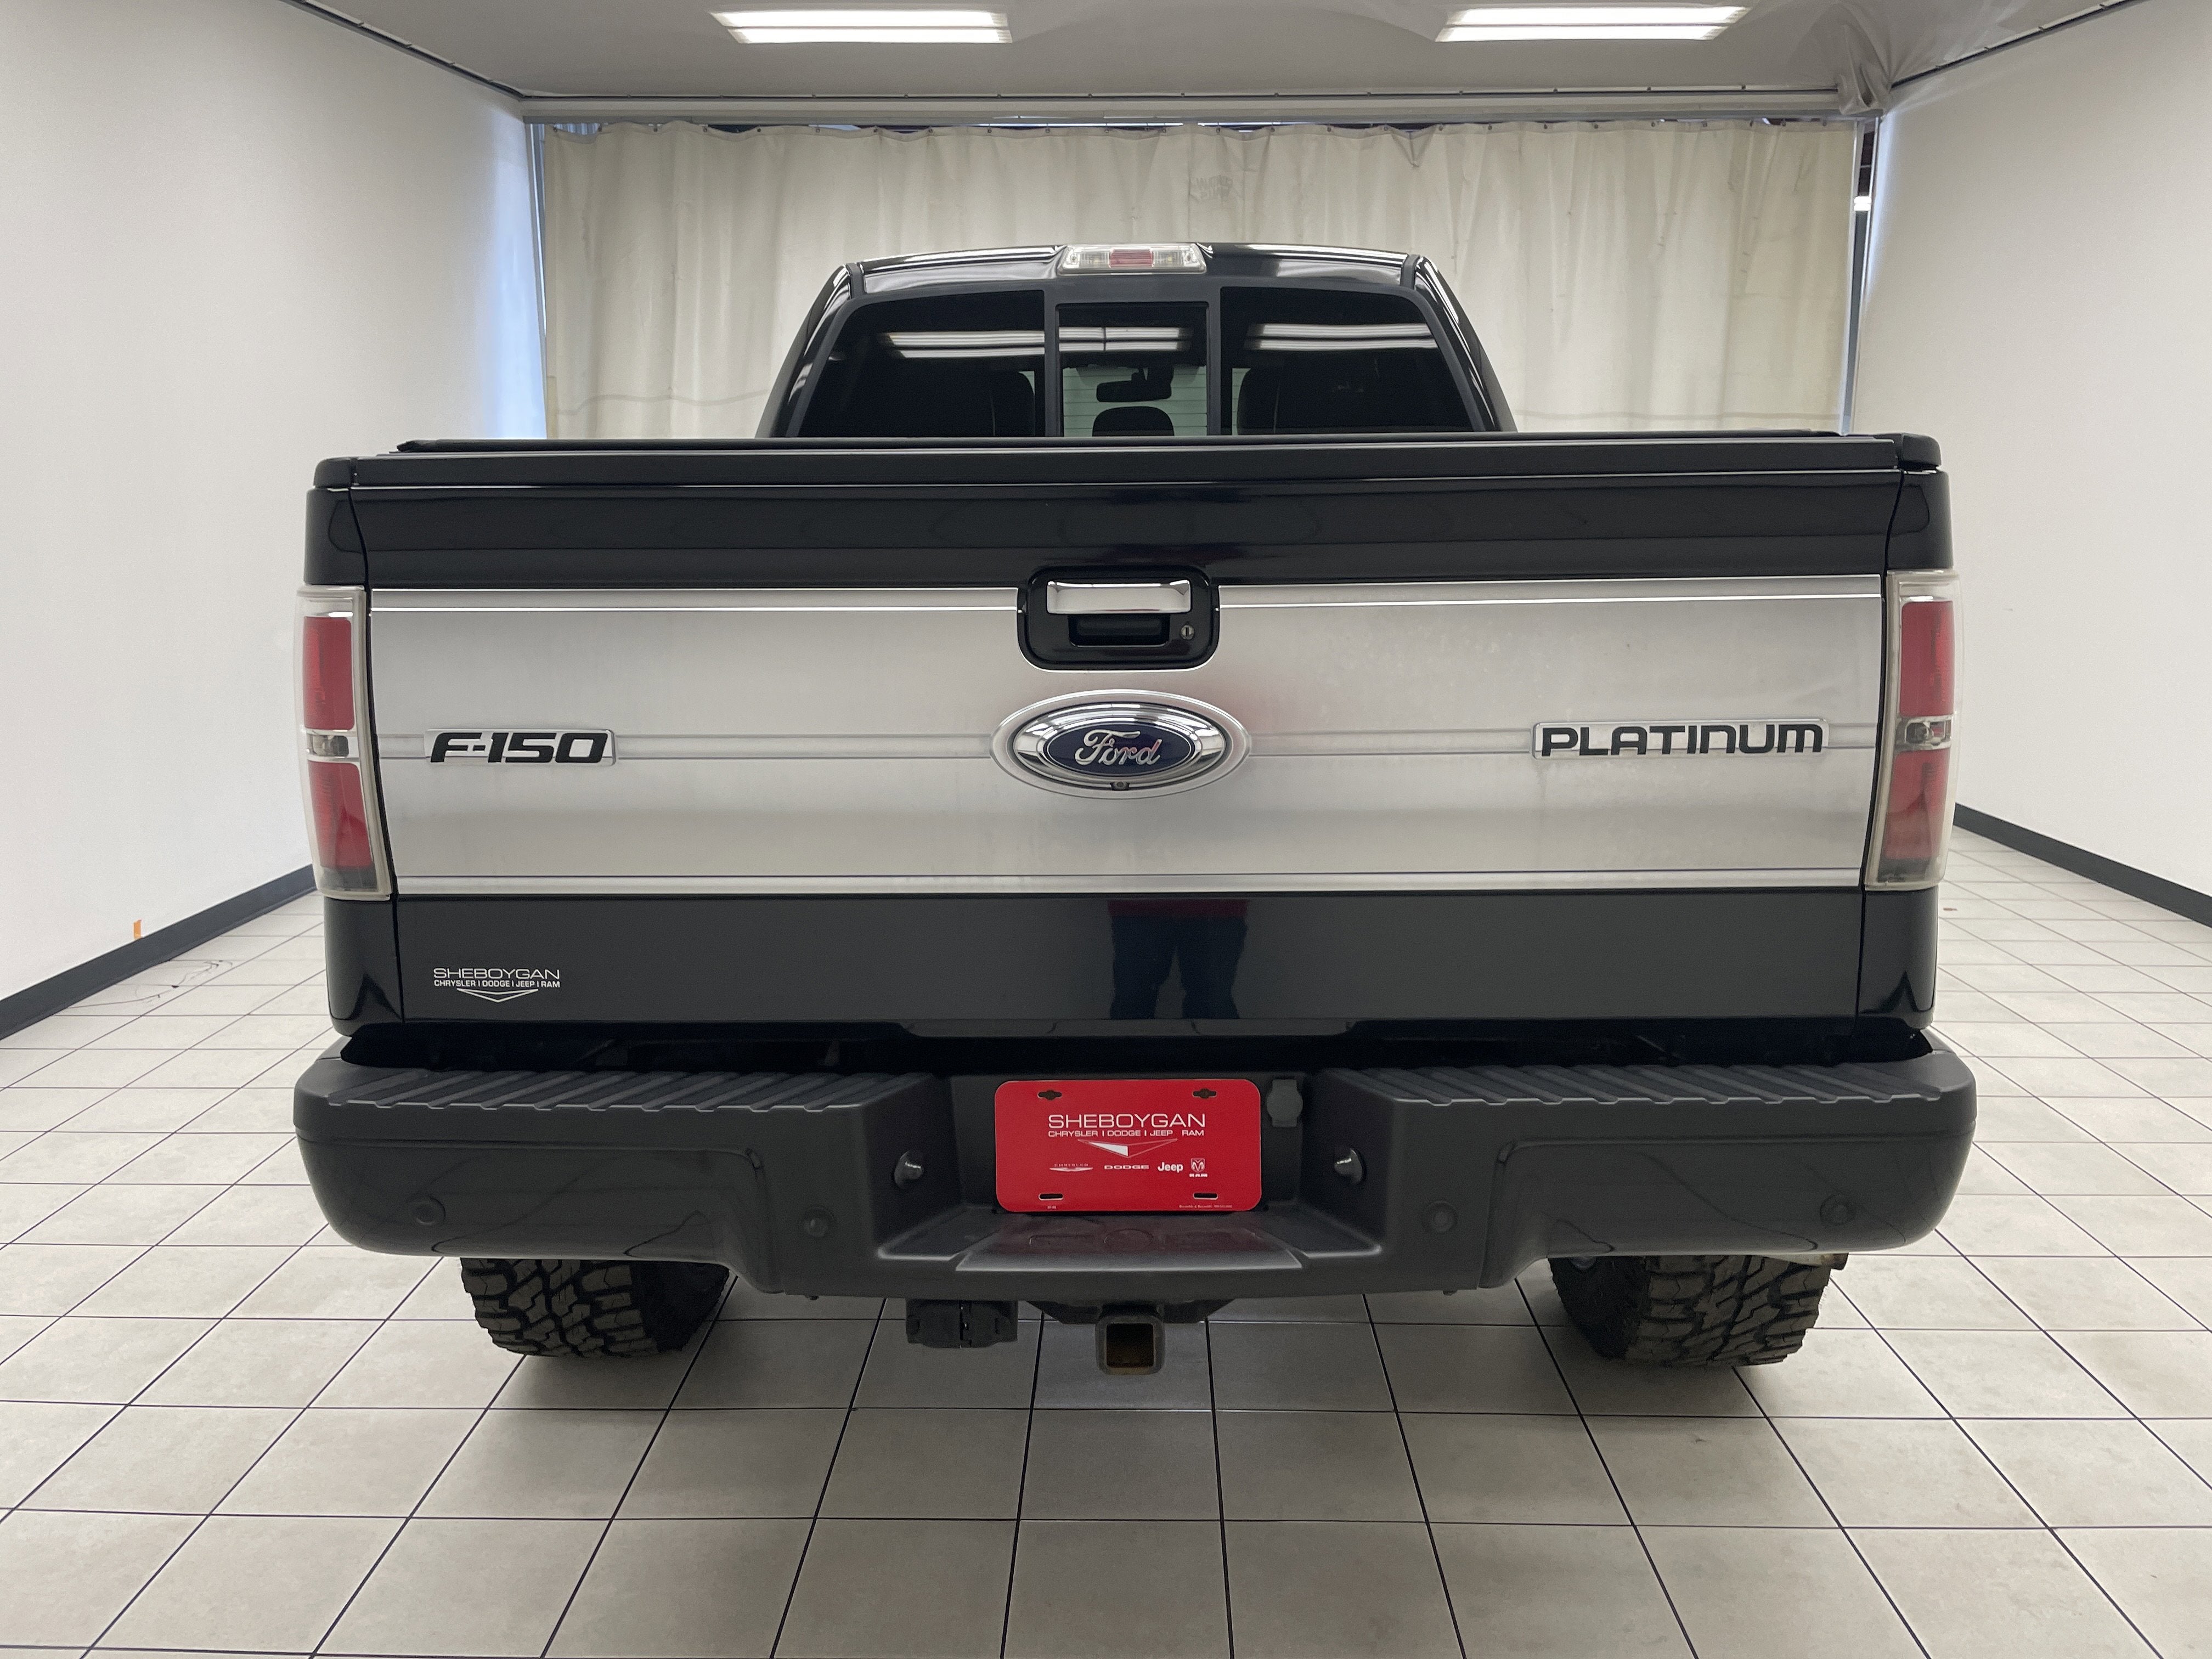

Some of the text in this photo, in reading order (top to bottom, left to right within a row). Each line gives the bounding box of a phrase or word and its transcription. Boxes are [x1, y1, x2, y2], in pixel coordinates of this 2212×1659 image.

[430, 732, 608, 763] F-150
[1074, 729, 1163, 766] Ford
[1541, 724, 1824, 757] PLATINUM
[433, 967, 560, 980] SHEBOYGAN
[1048, 1113, 1205, 1129] SHEBOYGAN
[1157, 1161, 1184, 1173] Jeep
